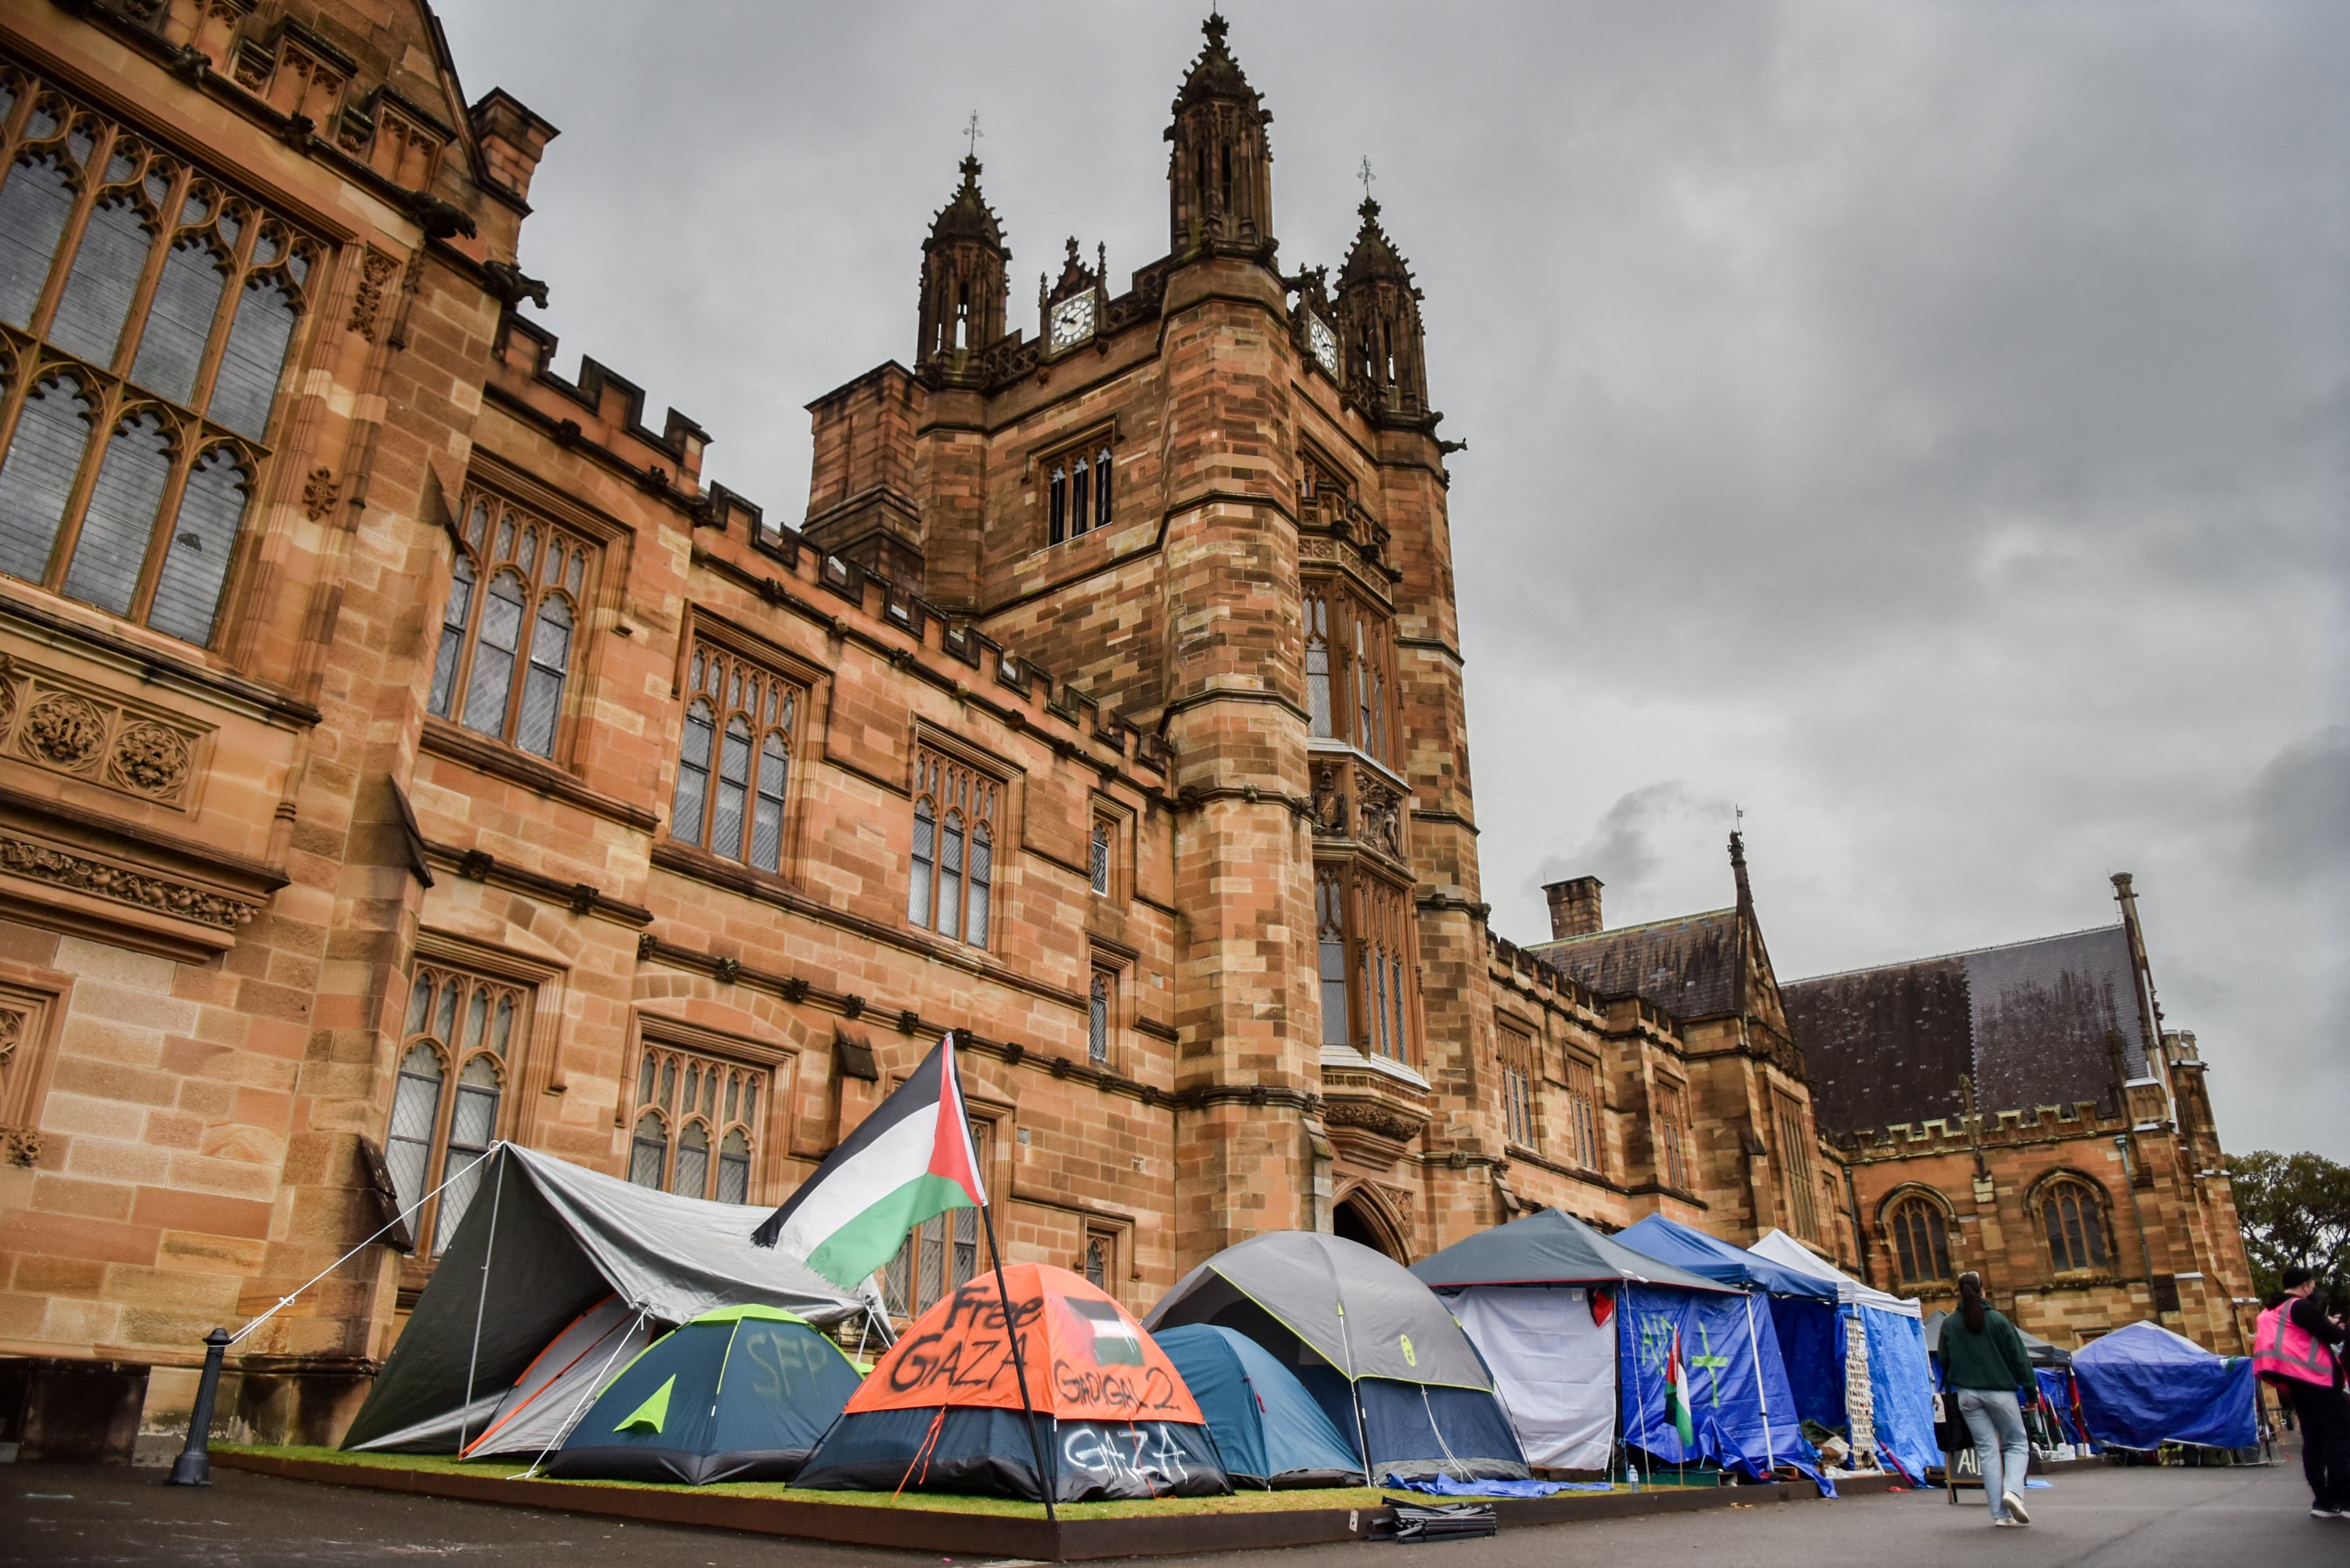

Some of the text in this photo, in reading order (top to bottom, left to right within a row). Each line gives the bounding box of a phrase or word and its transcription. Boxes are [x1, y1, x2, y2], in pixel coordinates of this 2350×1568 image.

[942, 1286, 1045, 1331] Free
[890, 1331, 1028, 1393] GAZA
[1054, 1359, 1181, 1412] GADIGAL 2
[1064, 1423, 1188, 1485] GAZA
